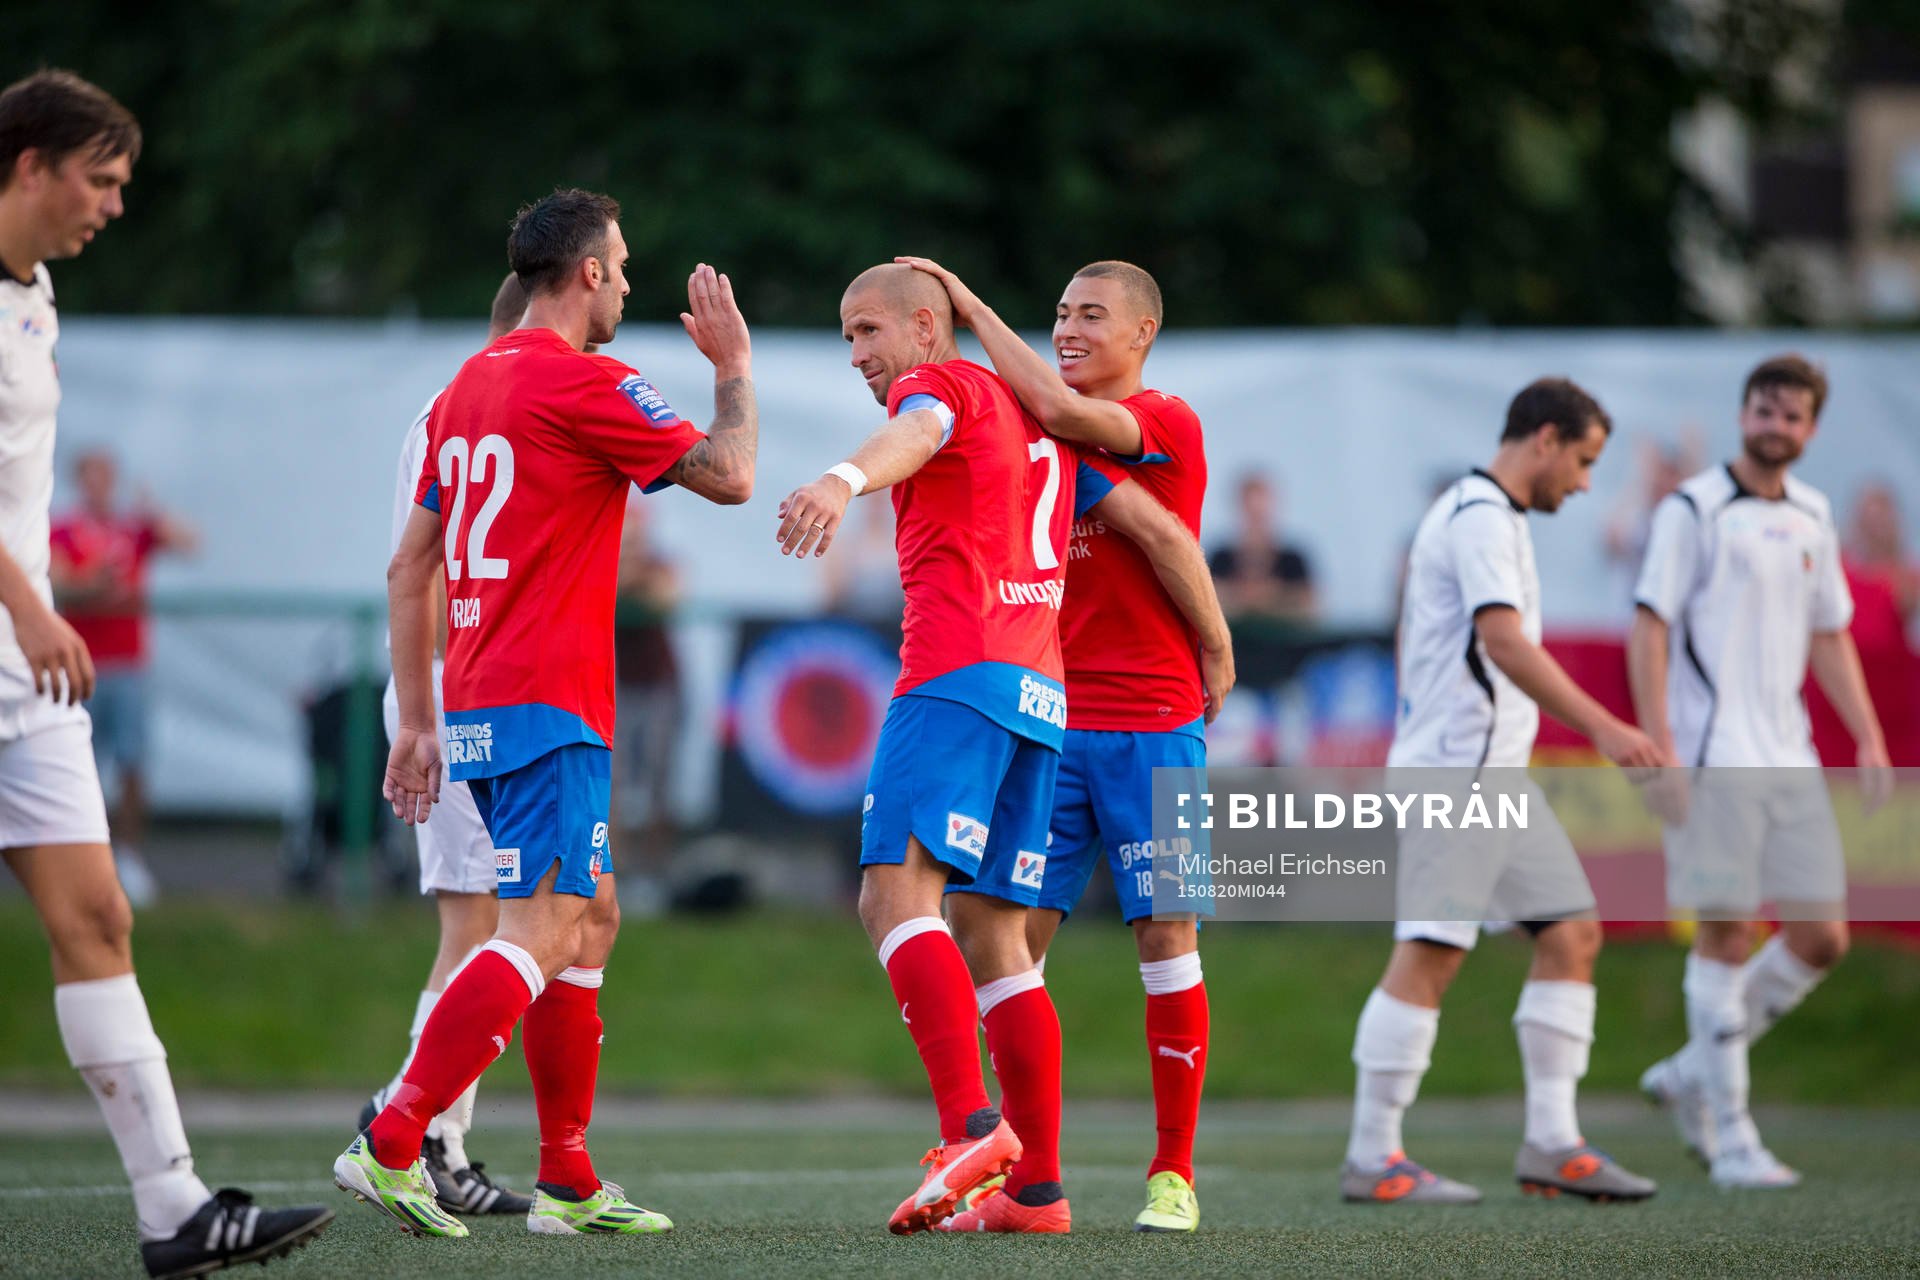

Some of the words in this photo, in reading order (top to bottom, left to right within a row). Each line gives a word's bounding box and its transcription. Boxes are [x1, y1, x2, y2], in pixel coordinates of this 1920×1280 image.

[438, 433, 515, 581] 22
[1028, 437, 1061, 570] 7
[1131, 836, 1192, 861] SOLID
[1135, 870, 1155, 898] 18
